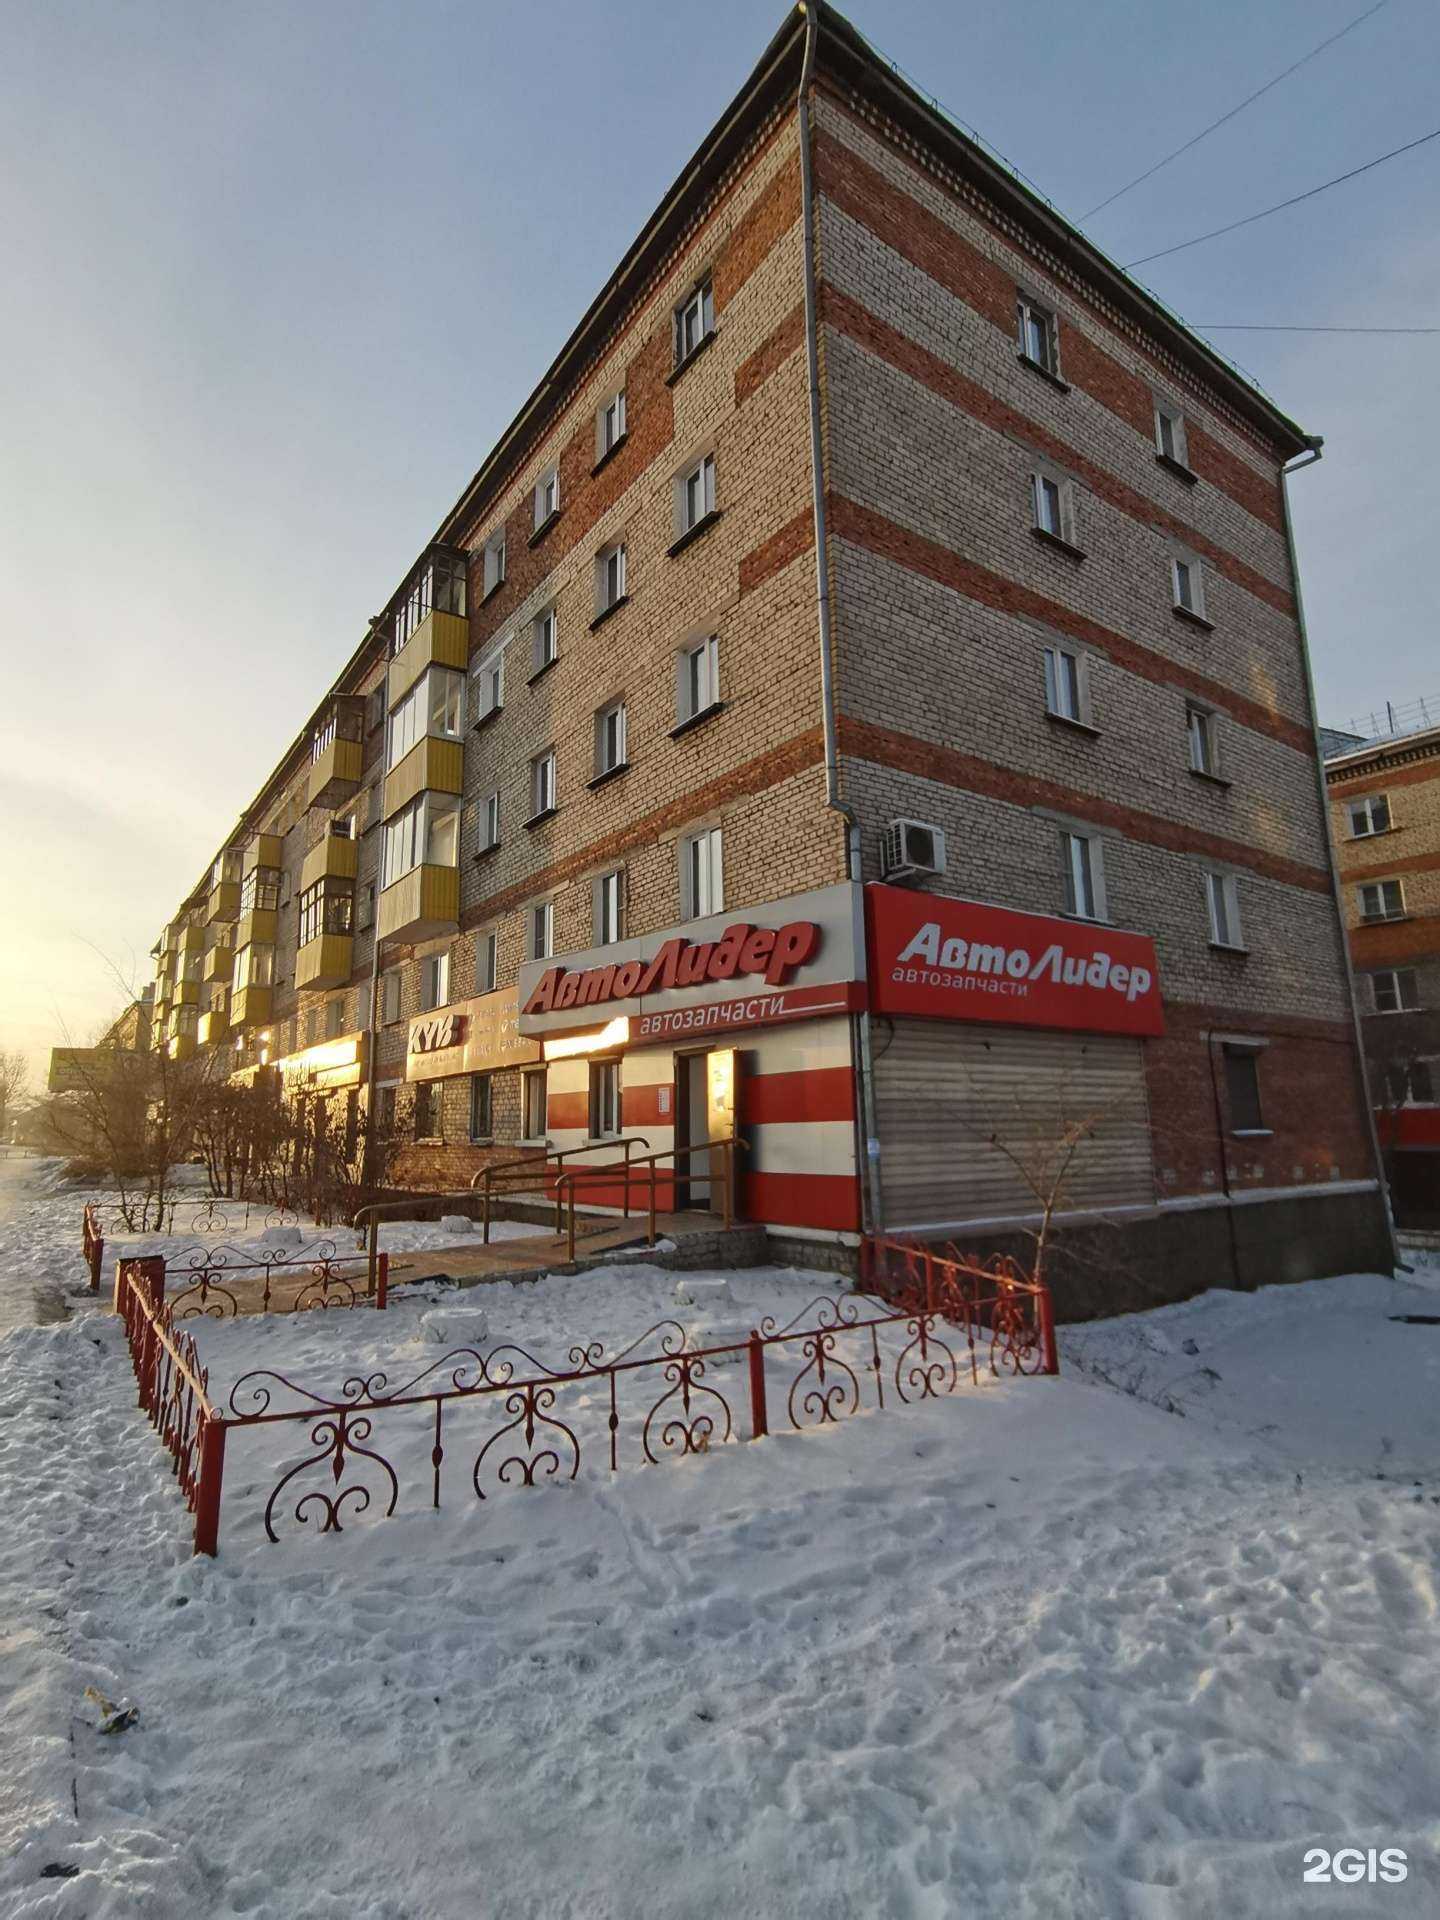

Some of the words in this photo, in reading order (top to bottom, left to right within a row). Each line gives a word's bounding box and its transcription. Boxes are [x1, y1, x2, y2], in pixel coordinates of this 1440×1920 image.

[522, 921, 821, 1014] АвтоЛидер
[892, 966, 1028, 997] автозапчасти
[897, 922, 1151, 1001] АвтоЛидер
[639, 995, 786, 1035] автозапчасти
